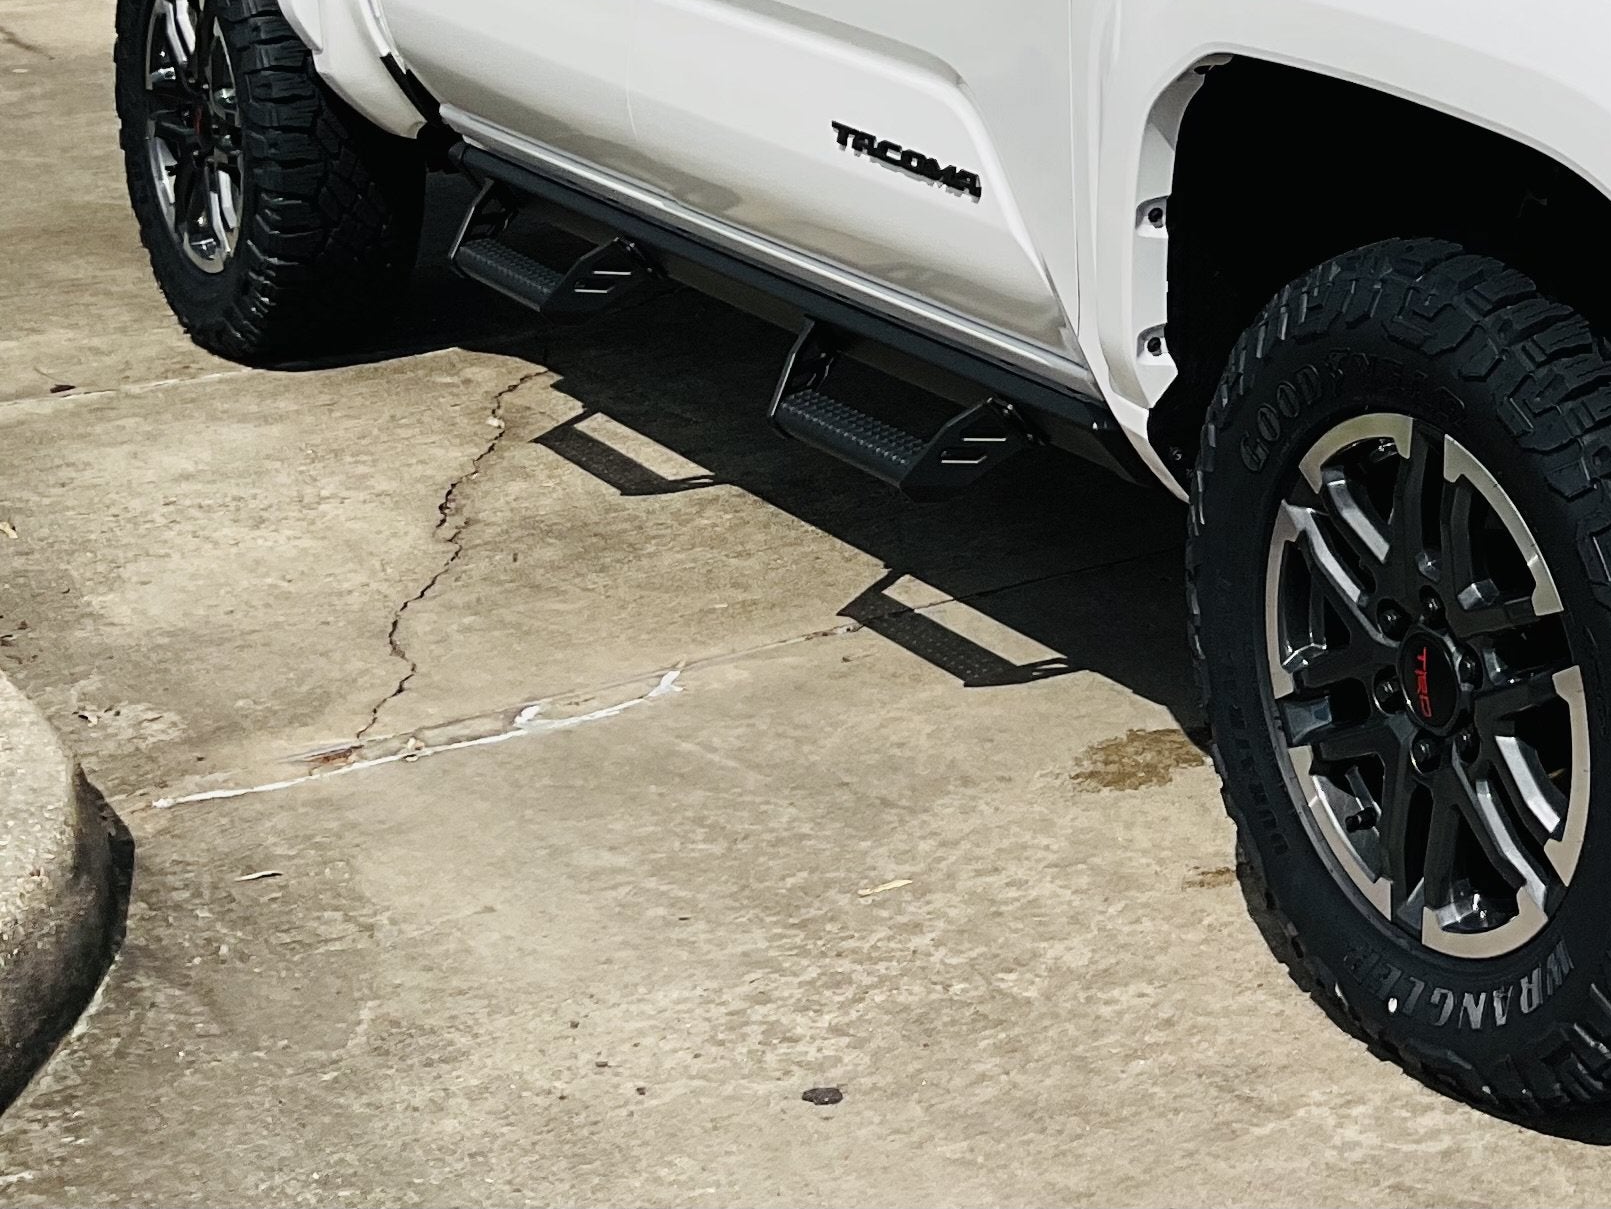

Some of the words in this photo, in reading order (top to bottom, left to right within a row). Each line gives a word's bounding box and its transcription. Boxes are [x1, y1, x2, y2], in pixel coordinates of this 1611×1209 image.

[831, 120, 982, 198] TACOMA
[1413, 647, 1433, 719] TRD
[1342, 935, 1575, 1030] WRANGLER
